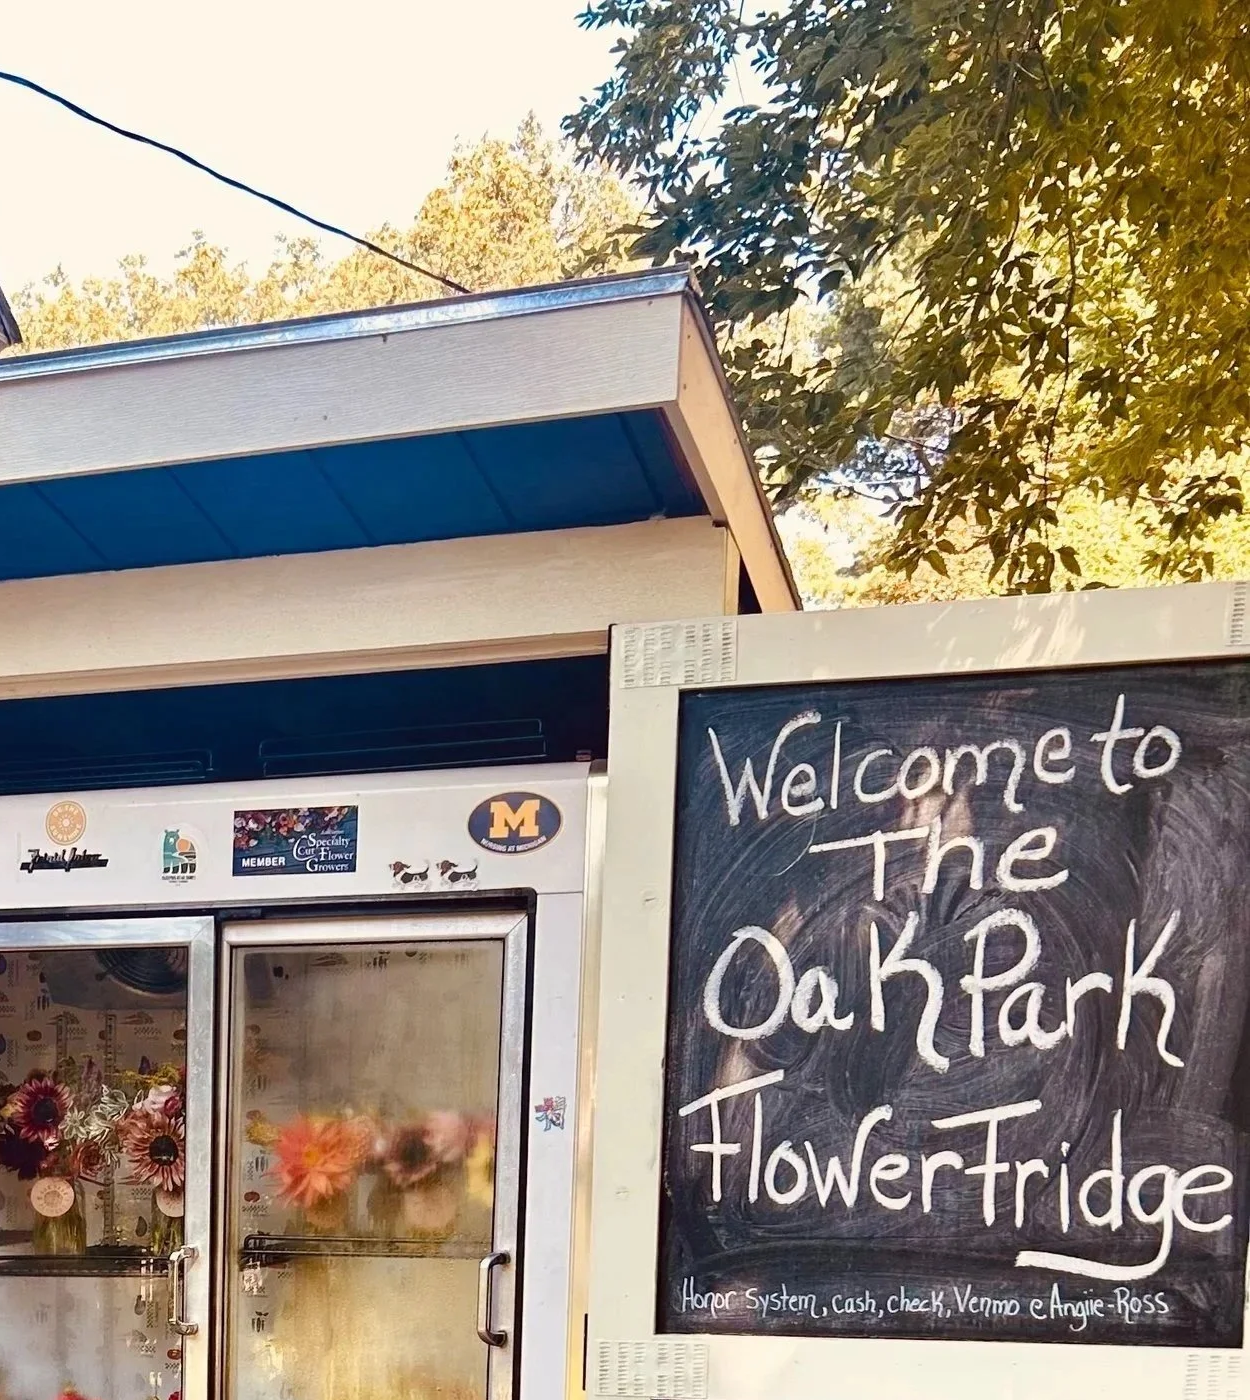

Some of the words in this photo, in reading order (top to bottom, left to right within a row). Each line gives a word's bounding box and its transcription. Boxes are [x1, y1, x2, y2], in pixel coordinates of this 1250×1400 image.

[707, 709, 1078, 827] Welcome
[1089, 693, 1182, 796] to
[489, 799, 541, 839] M
[307, 832, 351, 849] Specialty
[318, 846, 355, 861] Flower
[809, 816, 1069, 902] The
[241, 856, 287, 868] MEMBER
[305, 857, 350, 873] Growers
[680, 1068, 965, 1214] Flower
[931, 1099, 1234, 1281] Fridge
[681, 1275, 738, 1319] Honor
[953, 1283, 1021, 1318] Venmo
